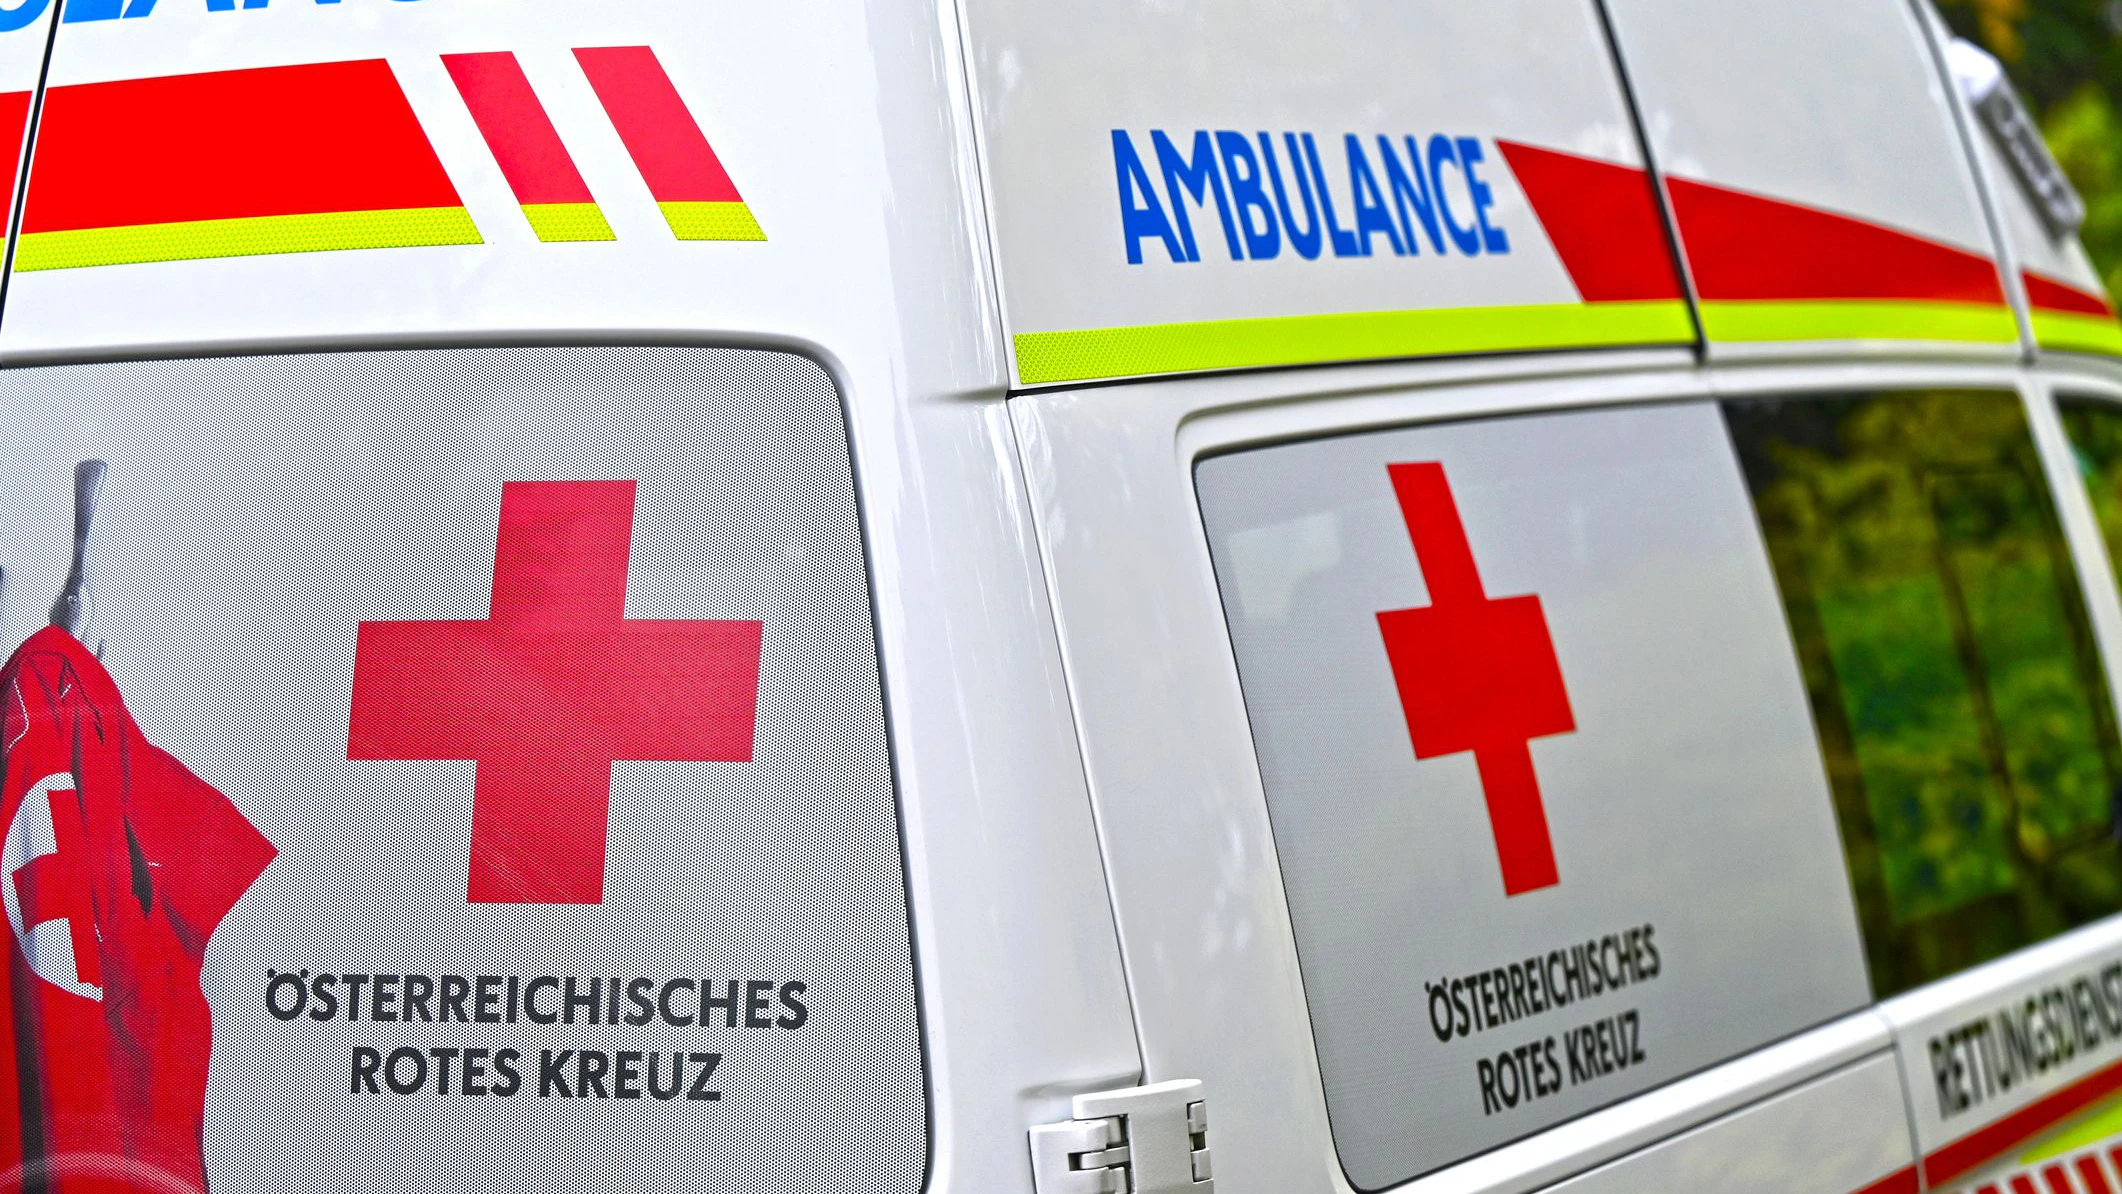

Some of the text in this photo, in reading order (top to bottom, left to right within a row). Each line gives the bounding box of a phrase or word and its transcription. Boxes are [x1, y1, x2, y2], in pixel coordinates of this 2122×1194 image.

[1111, 129, 1510, 264] AMBULANCE
[265, 969, 808, 1029] ÖSTERREICHISCHES
[1425, 923, 1661, 1043] ÖSTERREICHISCHES
[350, 1046, 722, 1101] ROTES KREUZ
[1477, 1008, 1646, 1116] ROTES KREUZ
